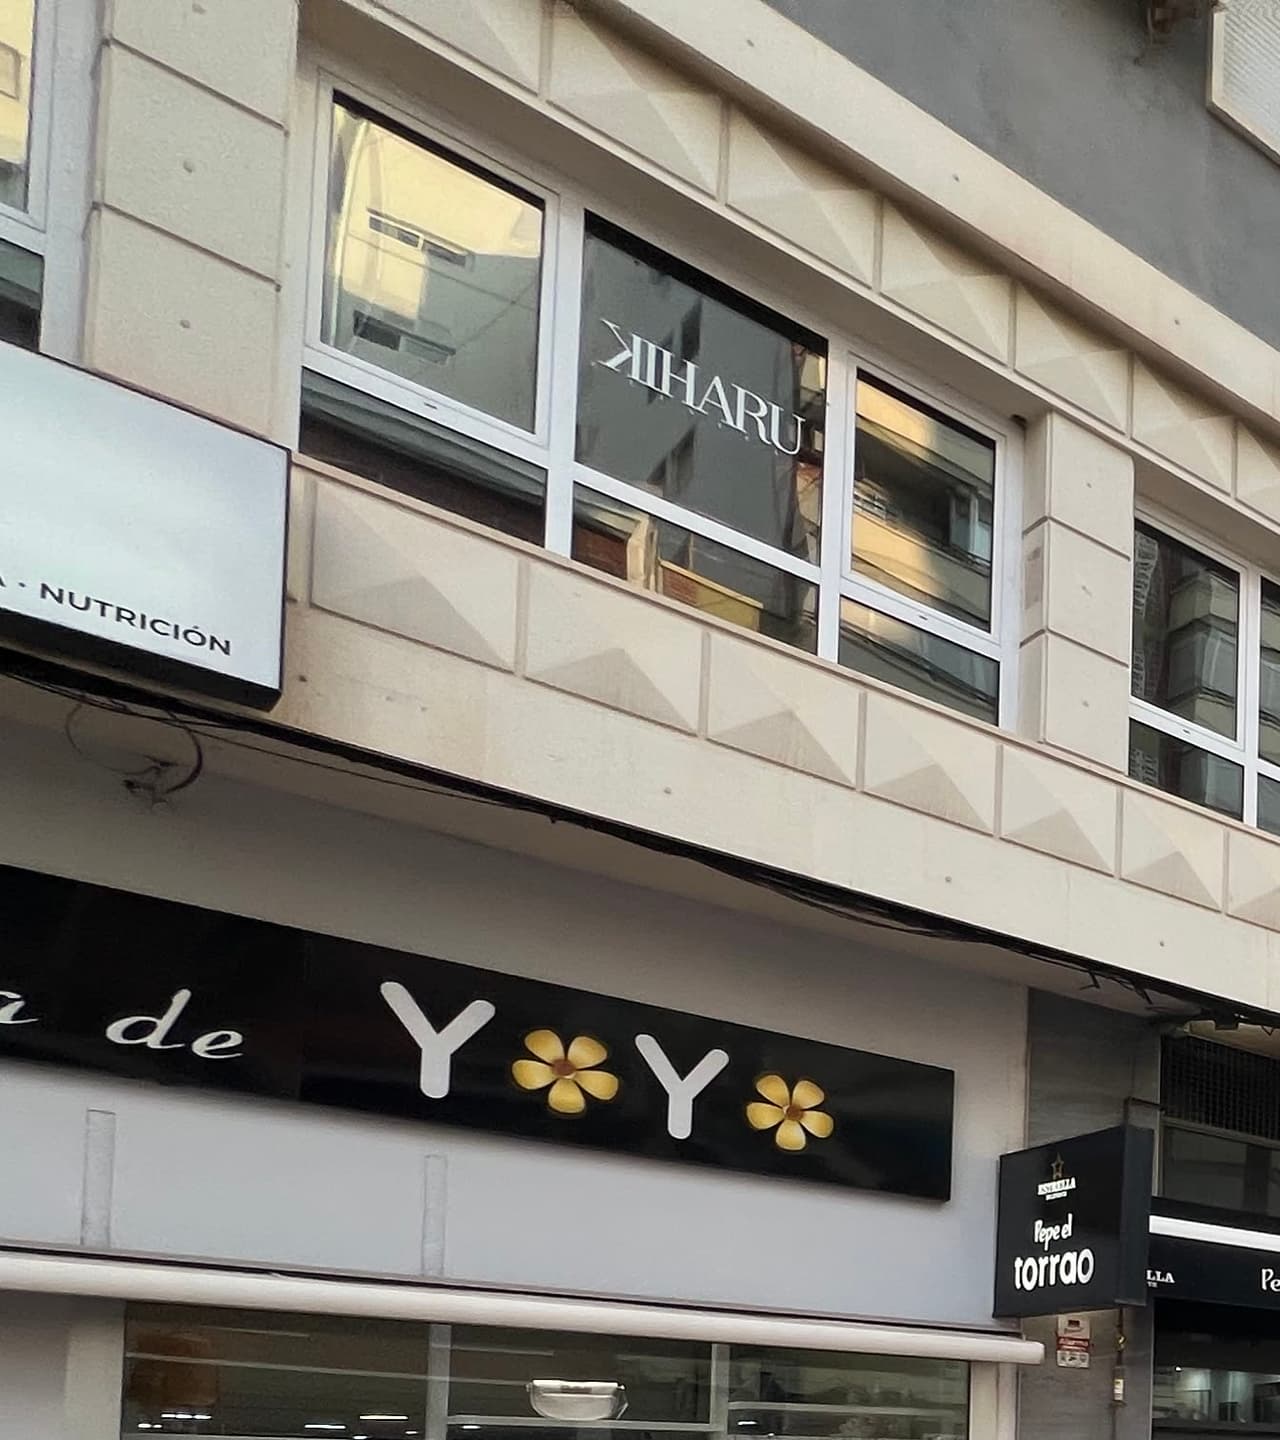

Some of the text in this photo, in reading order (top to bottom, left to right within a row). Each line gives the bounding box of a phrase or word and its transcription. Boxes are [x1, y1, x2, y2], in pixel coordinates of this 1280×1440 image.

[40, 583, 231, 656] NUTRICIÓN
[105, 988, 243, 1059] de
[1034, 1213, 1073, 1251] Pepe el
[1014, 1248, 1095, 1291] torrao
